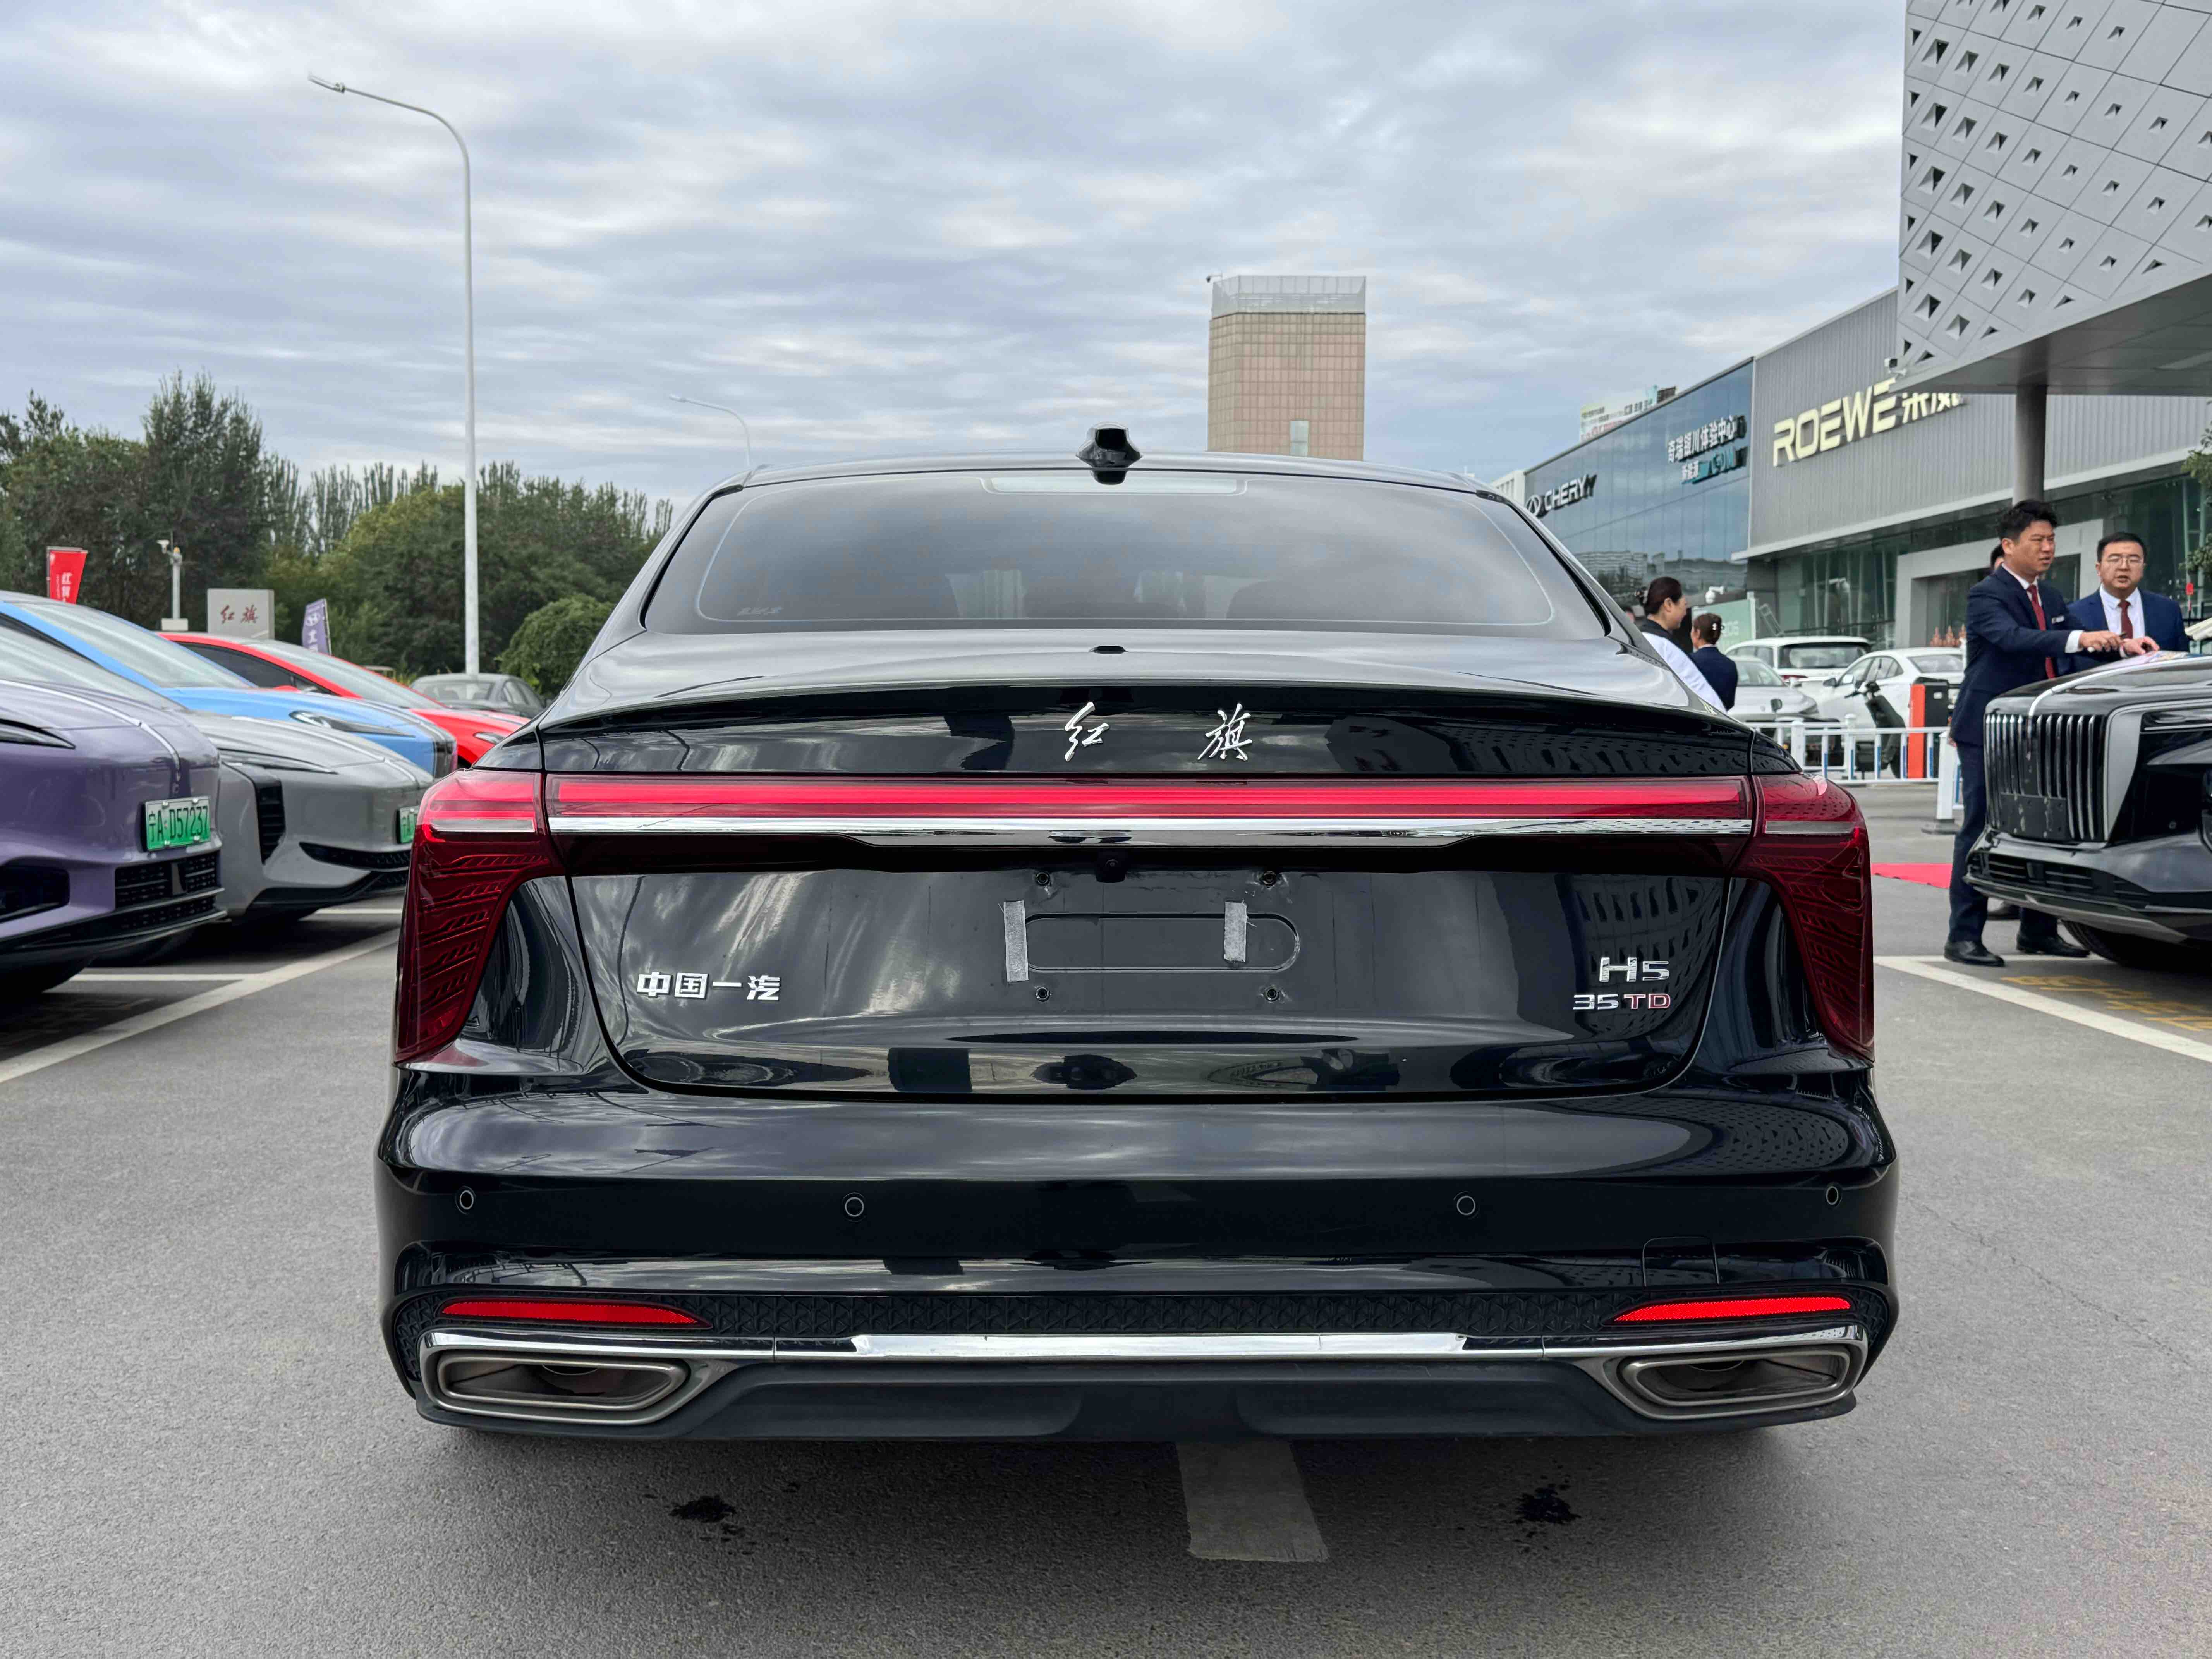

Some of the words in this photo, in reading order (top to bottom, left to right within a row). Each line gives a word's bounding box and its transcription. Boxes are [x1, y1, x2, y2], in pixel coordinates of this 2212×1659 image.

[1773, 377, 1896, 467] ROEWE
[1544, 474, 1586, 511] CHERY
[220, 604, 258, 625] 红旗
[1064, 701, 1253, 762] 红旗
[1599, 957, 1670, 982] H5
[636, 971, 781, 1001] 中国一汽
[1573, 993, 1671, 1010] 35TD
